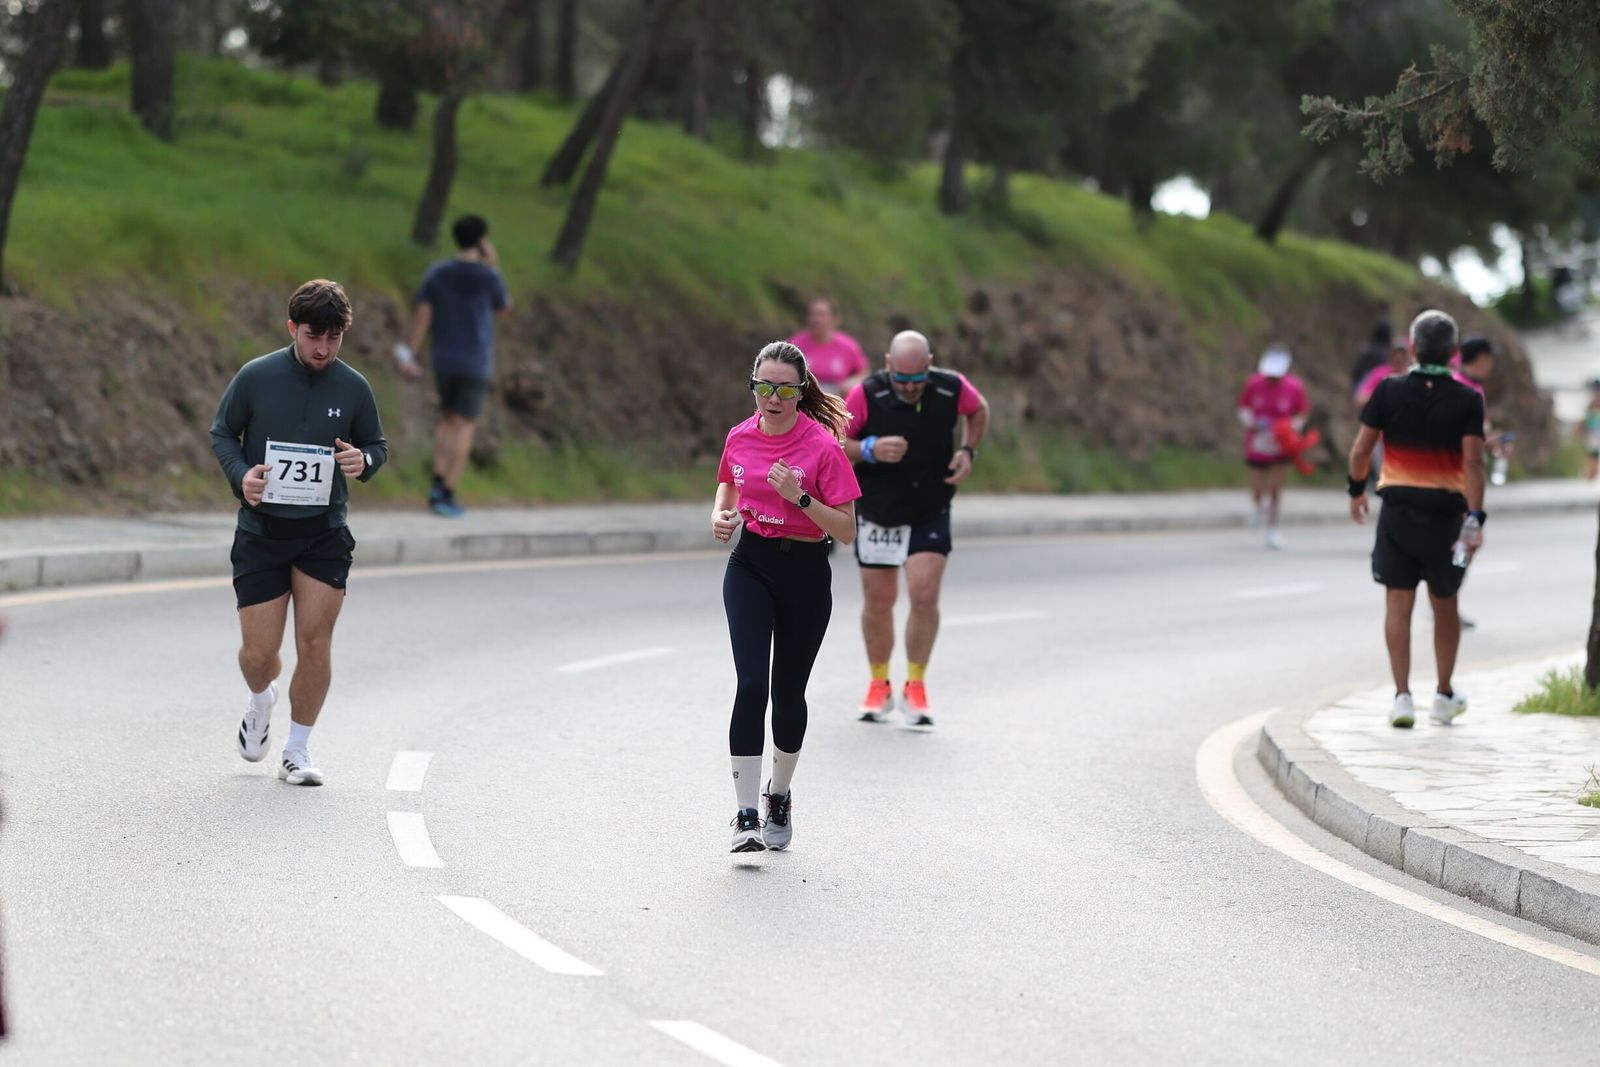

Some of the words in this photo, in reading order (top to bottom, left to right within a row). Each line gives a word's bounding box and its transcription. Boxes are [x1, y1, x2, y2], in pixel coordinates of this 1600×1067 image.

[278, 459, 323, 483] 731
[758, 514, 784, 525] Ciudad
[868, 529, 902, 546] 444
